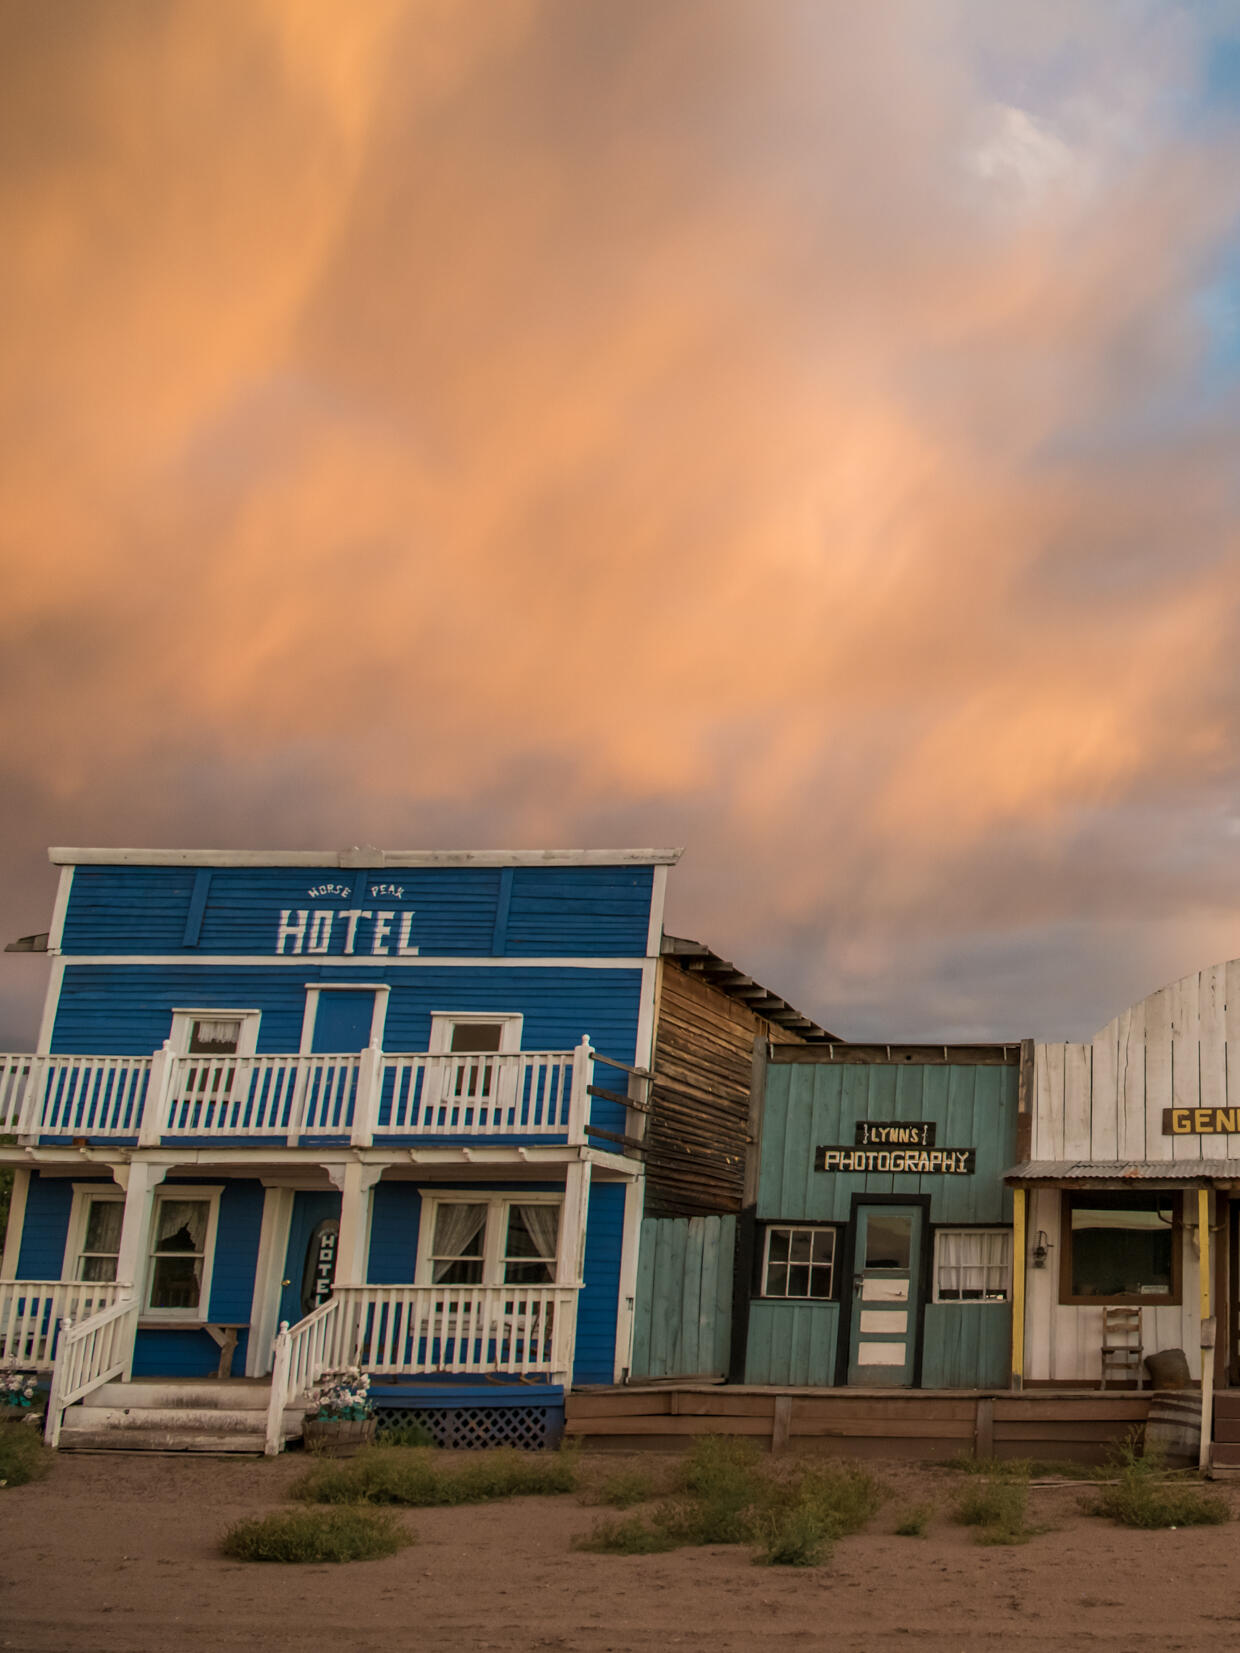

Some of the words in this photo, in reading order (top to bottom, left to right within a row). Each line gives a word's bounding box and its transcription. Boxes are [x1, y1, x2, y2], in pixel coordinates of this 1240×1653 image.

[308, 884, 351, 898] HORSE
[371, 885, 405, 899] PEAK
[275, 910, 419, 956] HOTEL
[871, 1126, 919, 1143] LYNN'S
[824, 1151, 970, 1173] PHOTOGRAPHY
